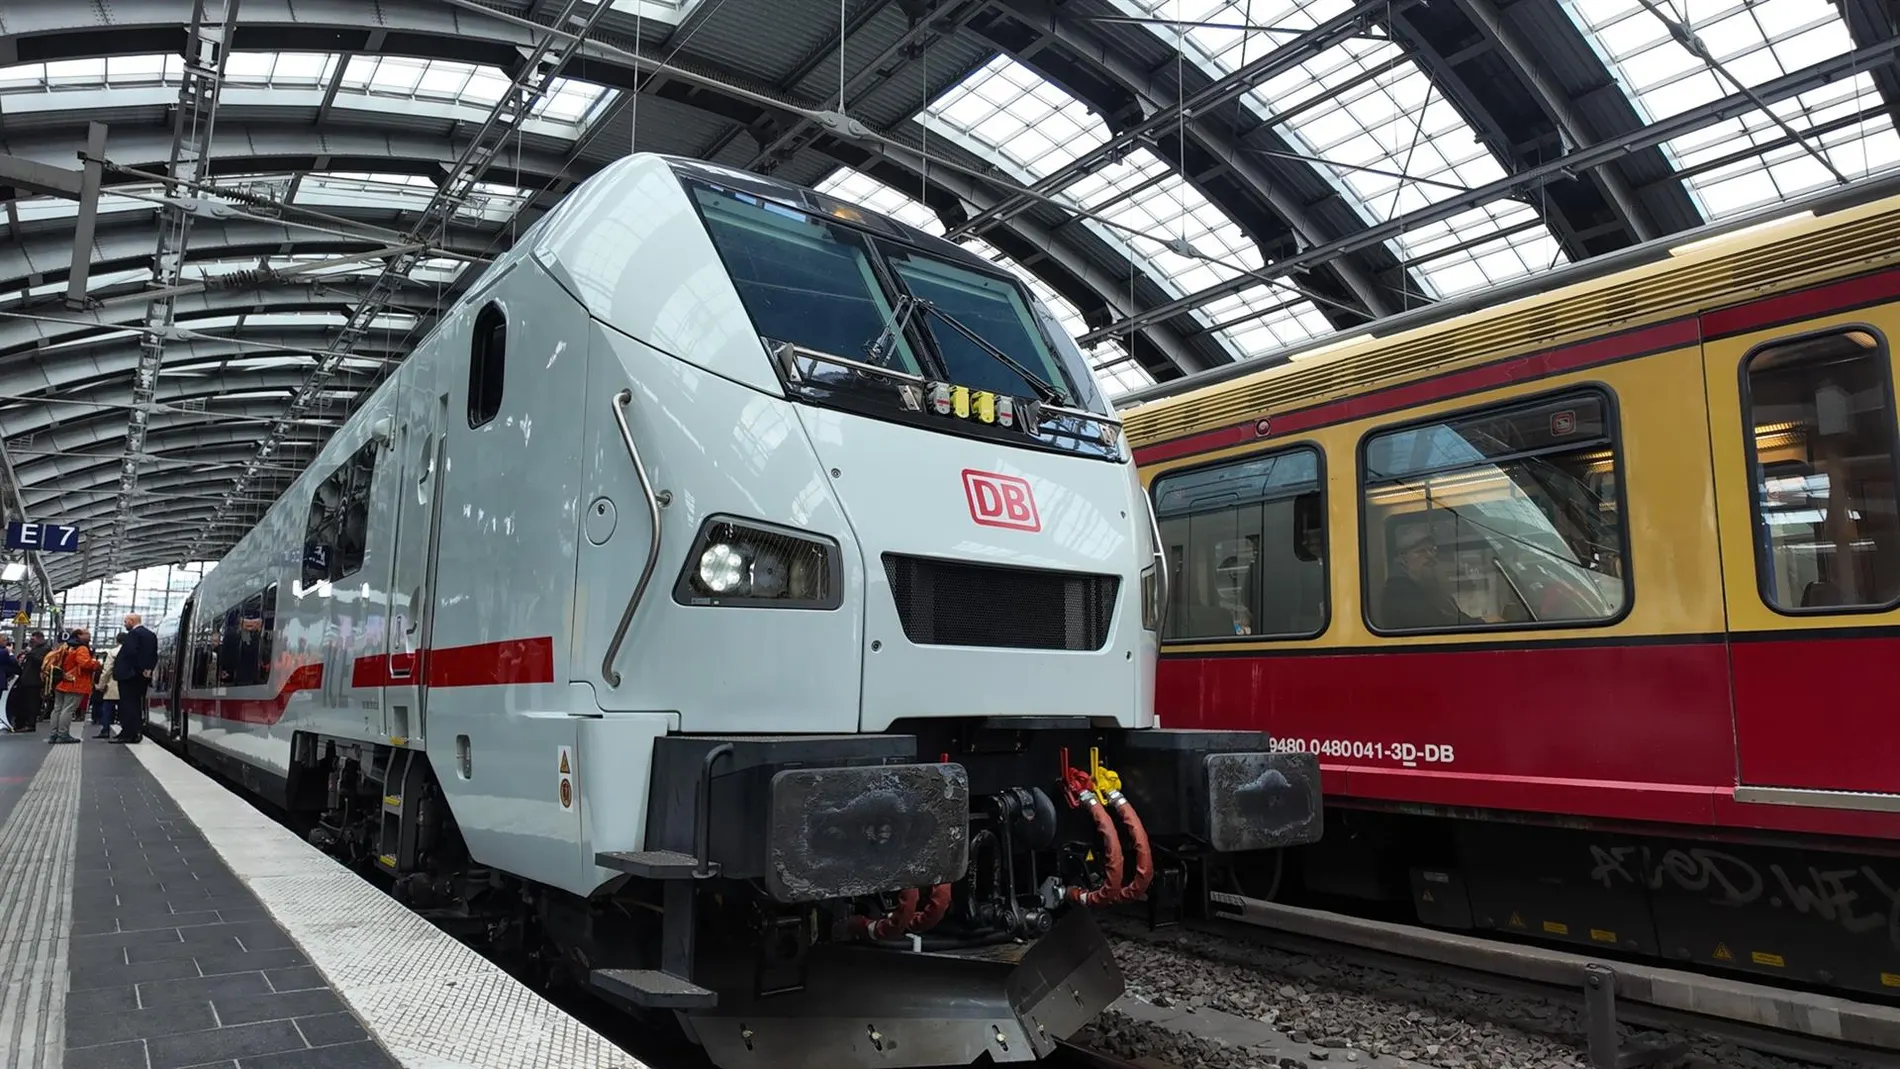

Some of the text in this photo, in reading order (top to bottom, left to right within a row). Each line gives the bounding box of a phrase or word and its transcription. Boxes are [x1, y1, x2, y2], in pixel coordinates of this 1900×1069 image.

[972, 478, 1030, 521] DB
[20, 524, 75, 546] E 7
